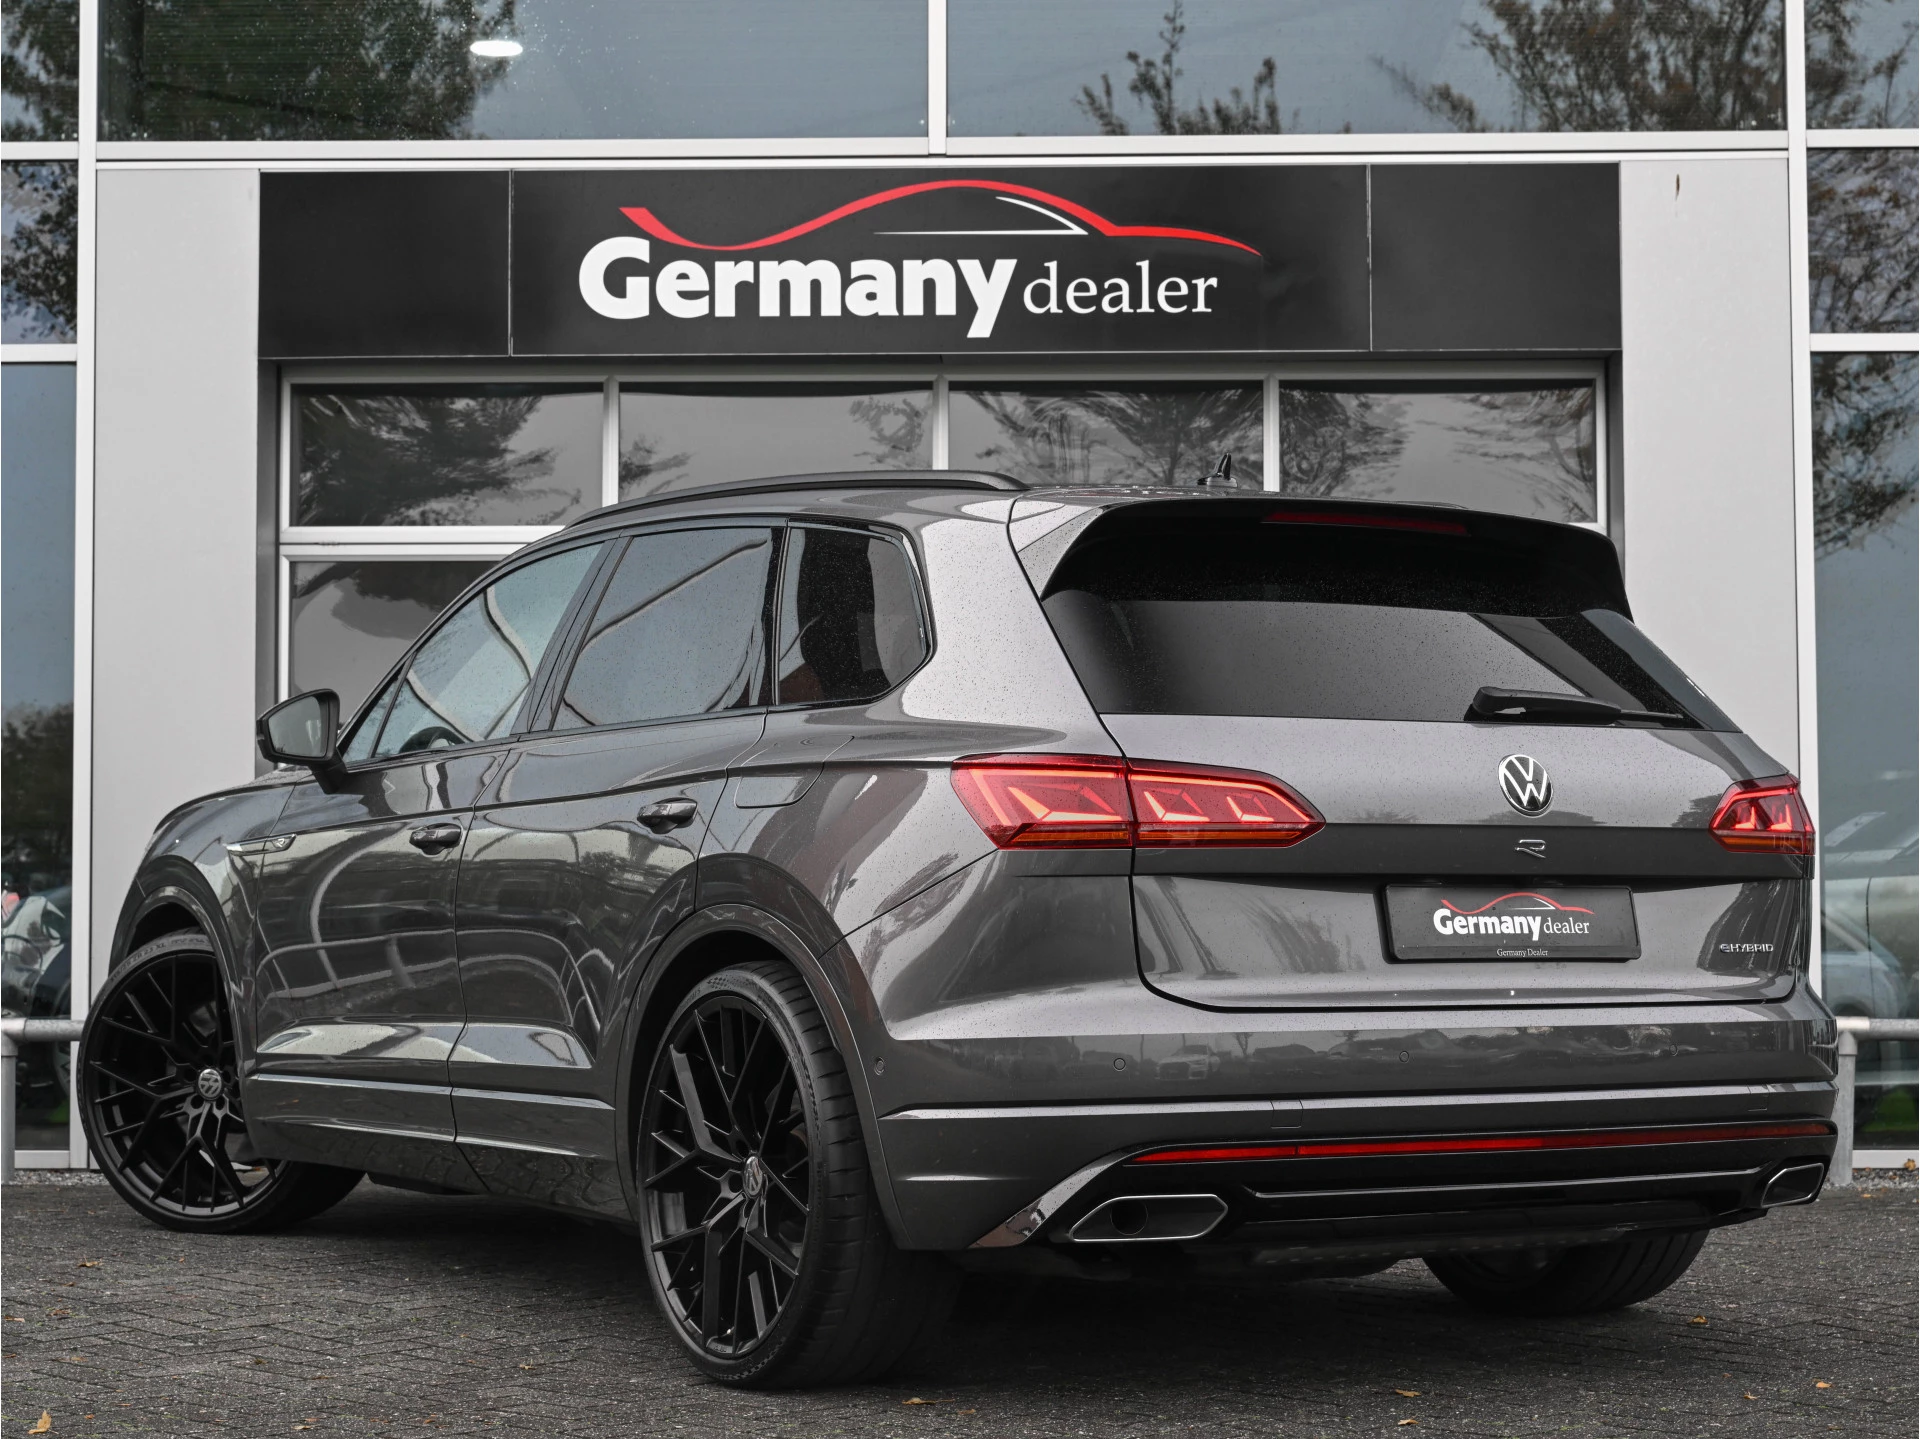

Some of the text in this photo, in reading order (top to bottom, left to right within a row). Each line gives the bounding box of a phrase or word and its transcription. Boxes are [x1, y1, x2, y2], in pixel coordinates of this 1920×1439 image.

[579, 236, 1218, 339] Germany dealer
[1433, 908, 1590, 942] Germany dealer
[1496, 948, 1548, 958] Germany Dealer
